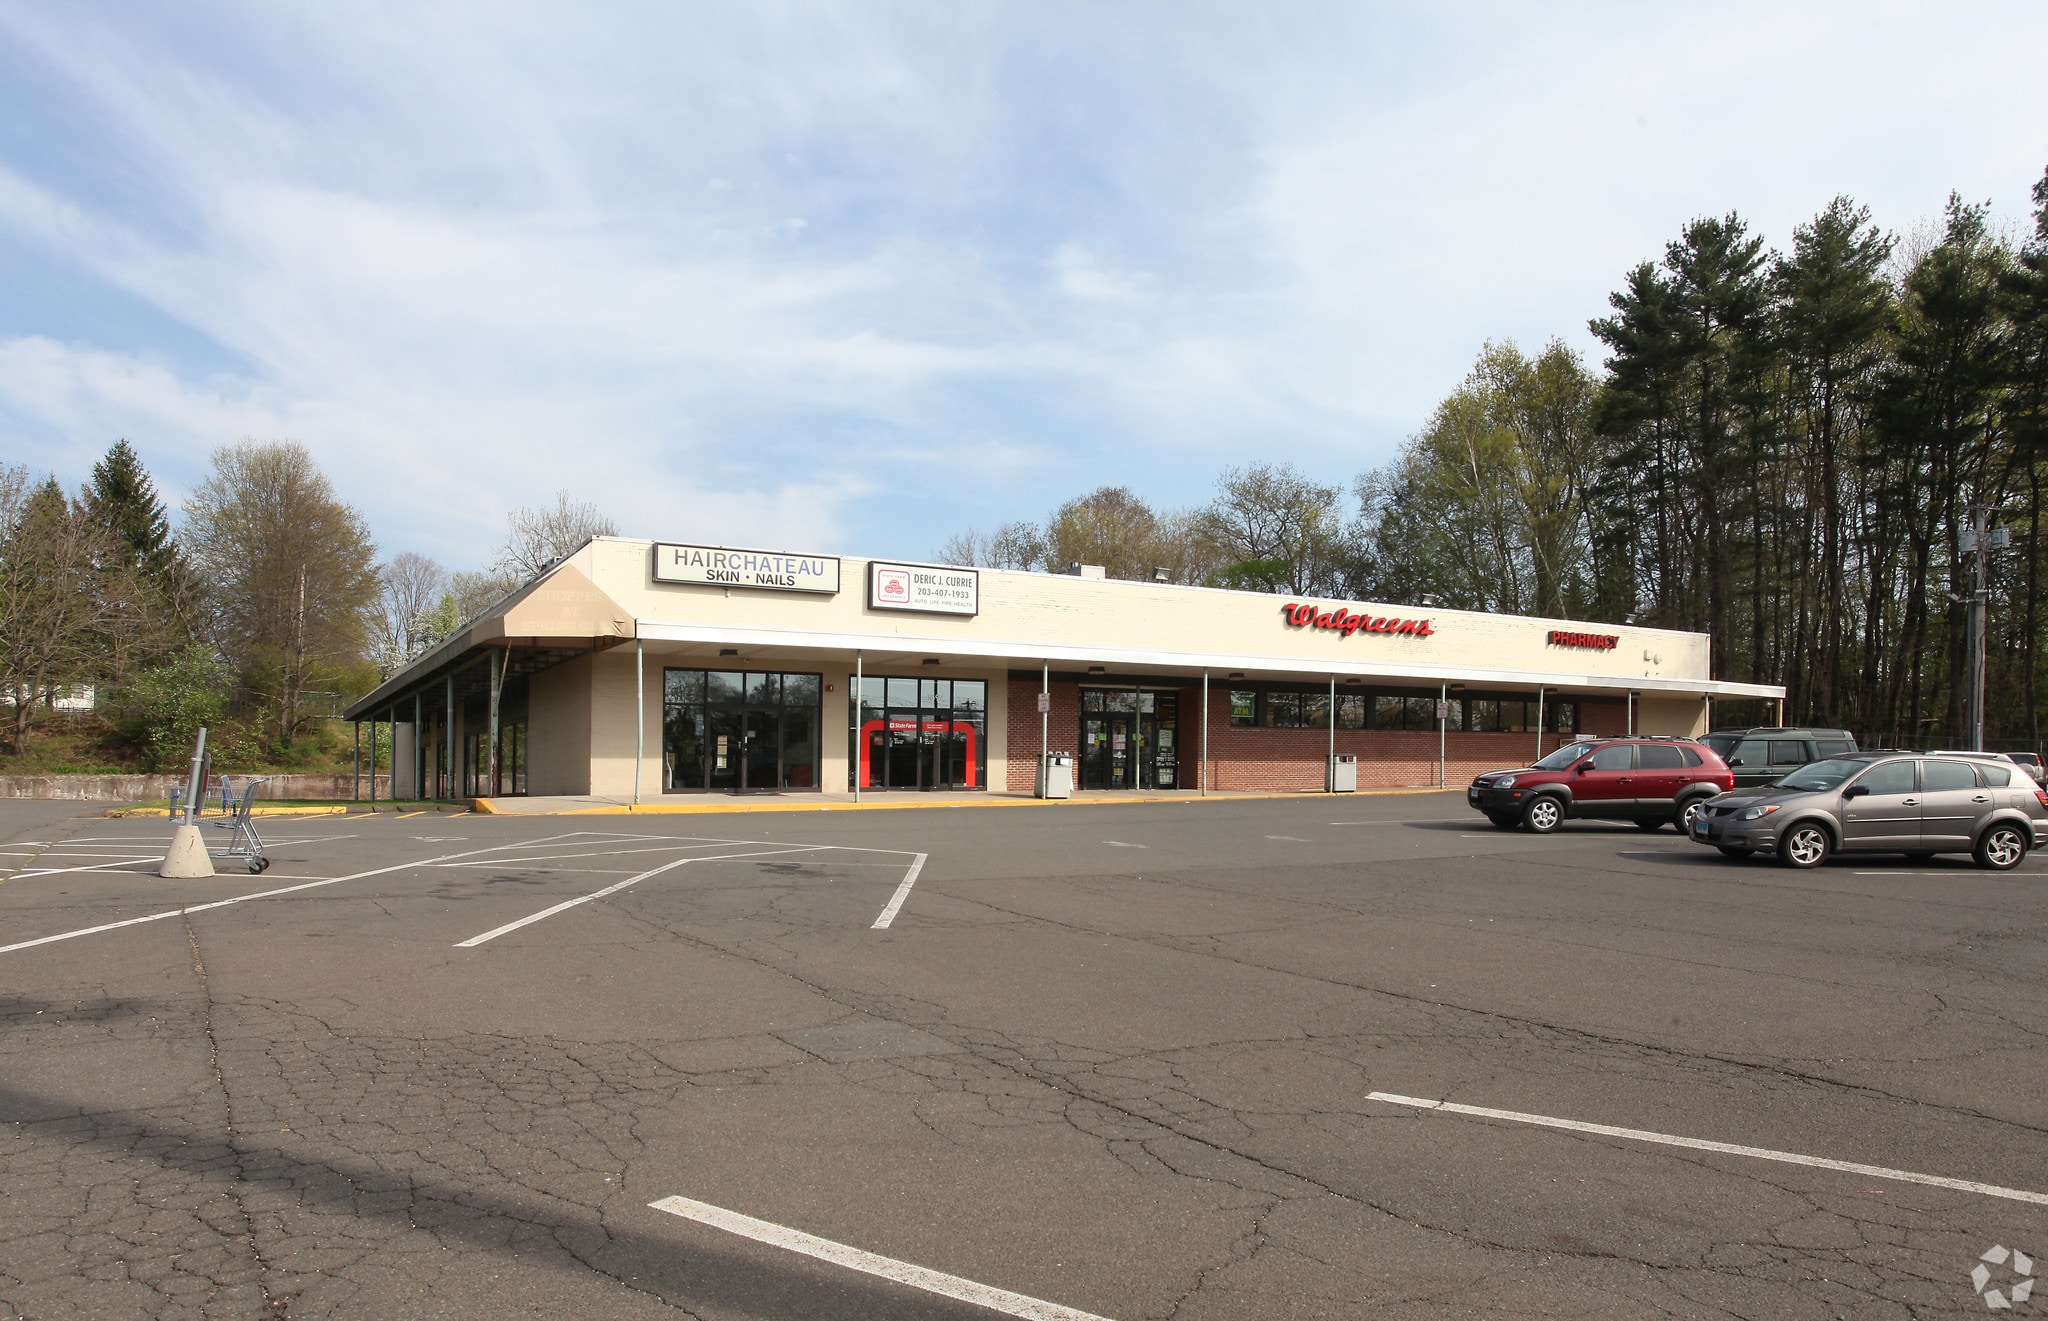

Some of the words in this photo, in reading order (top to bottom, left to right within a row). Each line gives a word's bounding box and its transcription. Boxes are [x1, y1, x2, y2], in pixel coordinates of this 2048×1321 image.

[674, 549, 824, 576] HAIRCHATEAU
[706, 569, 740, 582] SKIN
[755, 573, 795, 587] NAILS
[914, 573, 936, 585] DERIC
[938, 576, 943, 586] J.
[945, 576, 973, 588] CURRIE
[537, 590, 602, 602] SHOPPES
[917, 587, 970, 599] 203-407-1933
[562, 606, 580, 617] AT
[1283, 603, 1435, 637] Walgreens
[1551, 630, 1620, 649] PHARMACY
[1233, 707, 1249, 715] ATM
